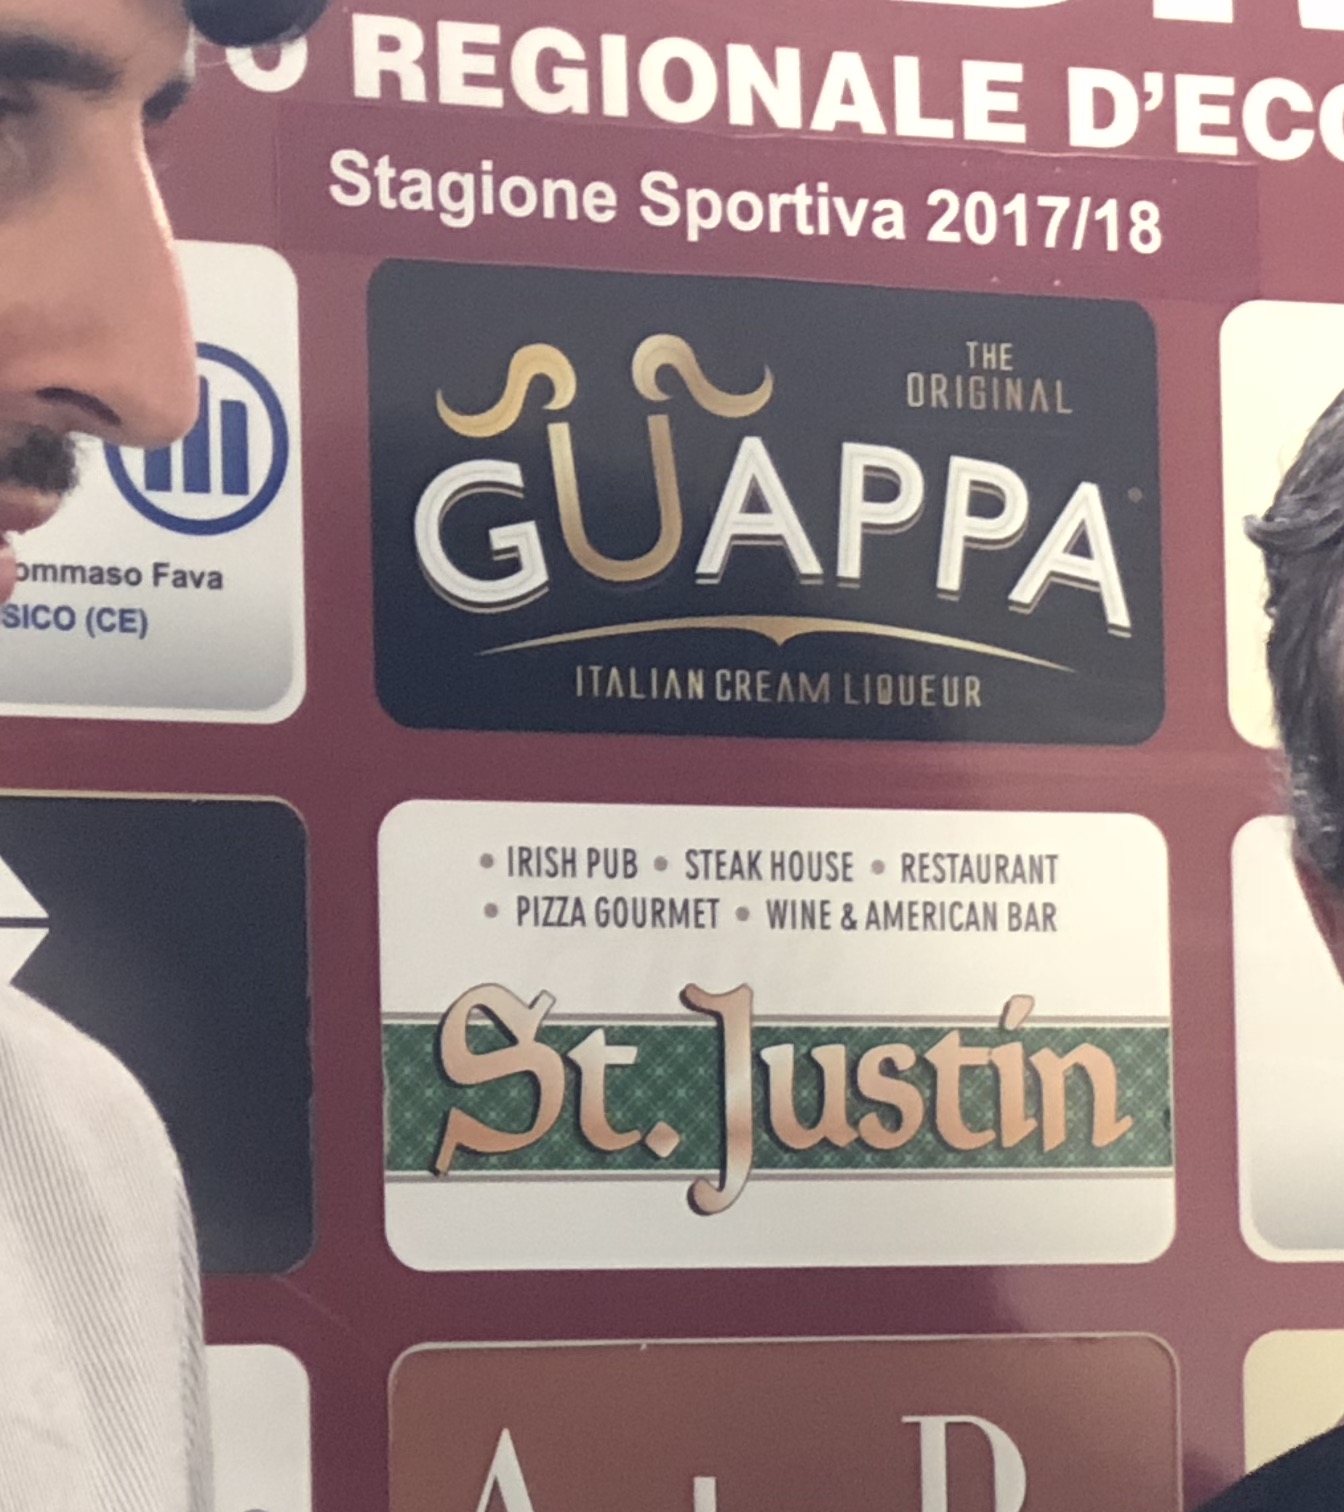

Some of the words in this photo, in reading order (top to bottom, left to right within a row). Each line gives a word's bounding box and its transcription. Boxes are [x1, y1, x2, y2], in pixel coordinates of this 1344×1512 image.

[352, 13, 1027, 145] REGIONALE
[329, 148, 618, 229] Stagione
[639, 170, 906, 242] Sportiva
[927, 188, 1163, 256] 2017/18
[965, 341, 1014, 371] THE
[906, 372, 1073, 415] ORIGINAL
[153, 562, 223, 590] Fava
[86, 606, 149, 640] (CE)
[575, 665, 704, 700] ITALIAN
[716, 669, 832, 705] CREAM
[845, 673, 982, 708] LIQUEUR
[507, 846, 577, 879] IRISH
[587, 848, 639, 880] PUB
[685, 849, 762, 881] STEAK
[771, 850, 854, 882] HOUSE
[900, 852, 1059, 885] RESTAURANT
[516, 896, 586, 927] PIZZA
[595, 898, 720, 929] GOURMET
[766, 899, 832, 931] WINE
[841, 902, 858, 931] &
[865, 900, 999, 933] AMERICAN
[1008, 902, 1058, 933] BAR
[428, 981, 681, 1176] St.
